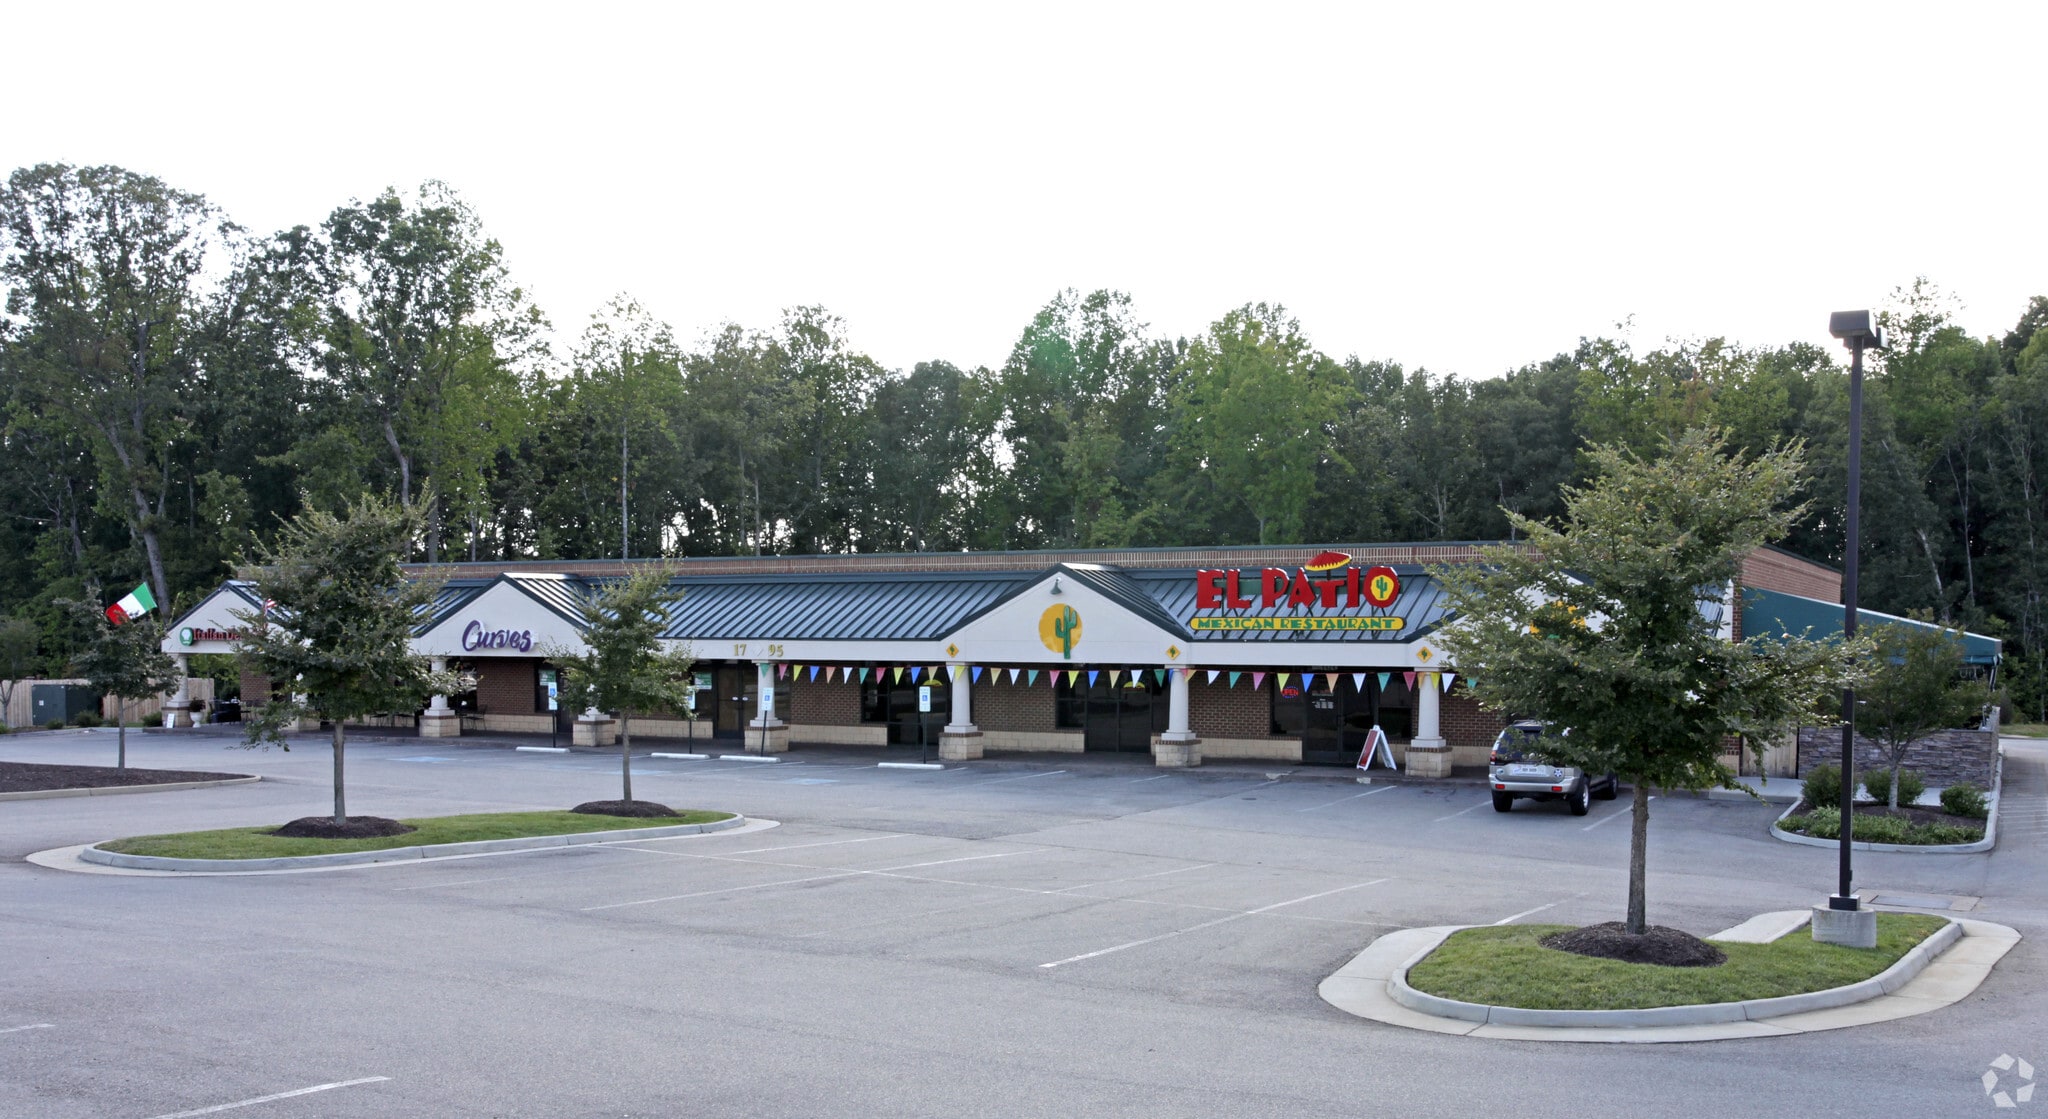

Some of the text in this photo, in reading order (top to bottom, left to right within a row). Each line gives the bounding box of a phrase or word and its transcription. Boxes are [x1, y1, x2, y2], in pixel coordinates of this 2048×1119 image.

[1196, 566, 1400, 608] EL PATIO
[1197, 617, 1395, 630] MEXICAN RESTAURANT
[193, 628, 224, 641] Italian
[462, 619, 531, 652] Curves
[733, 643, 784, 657] 17 95
